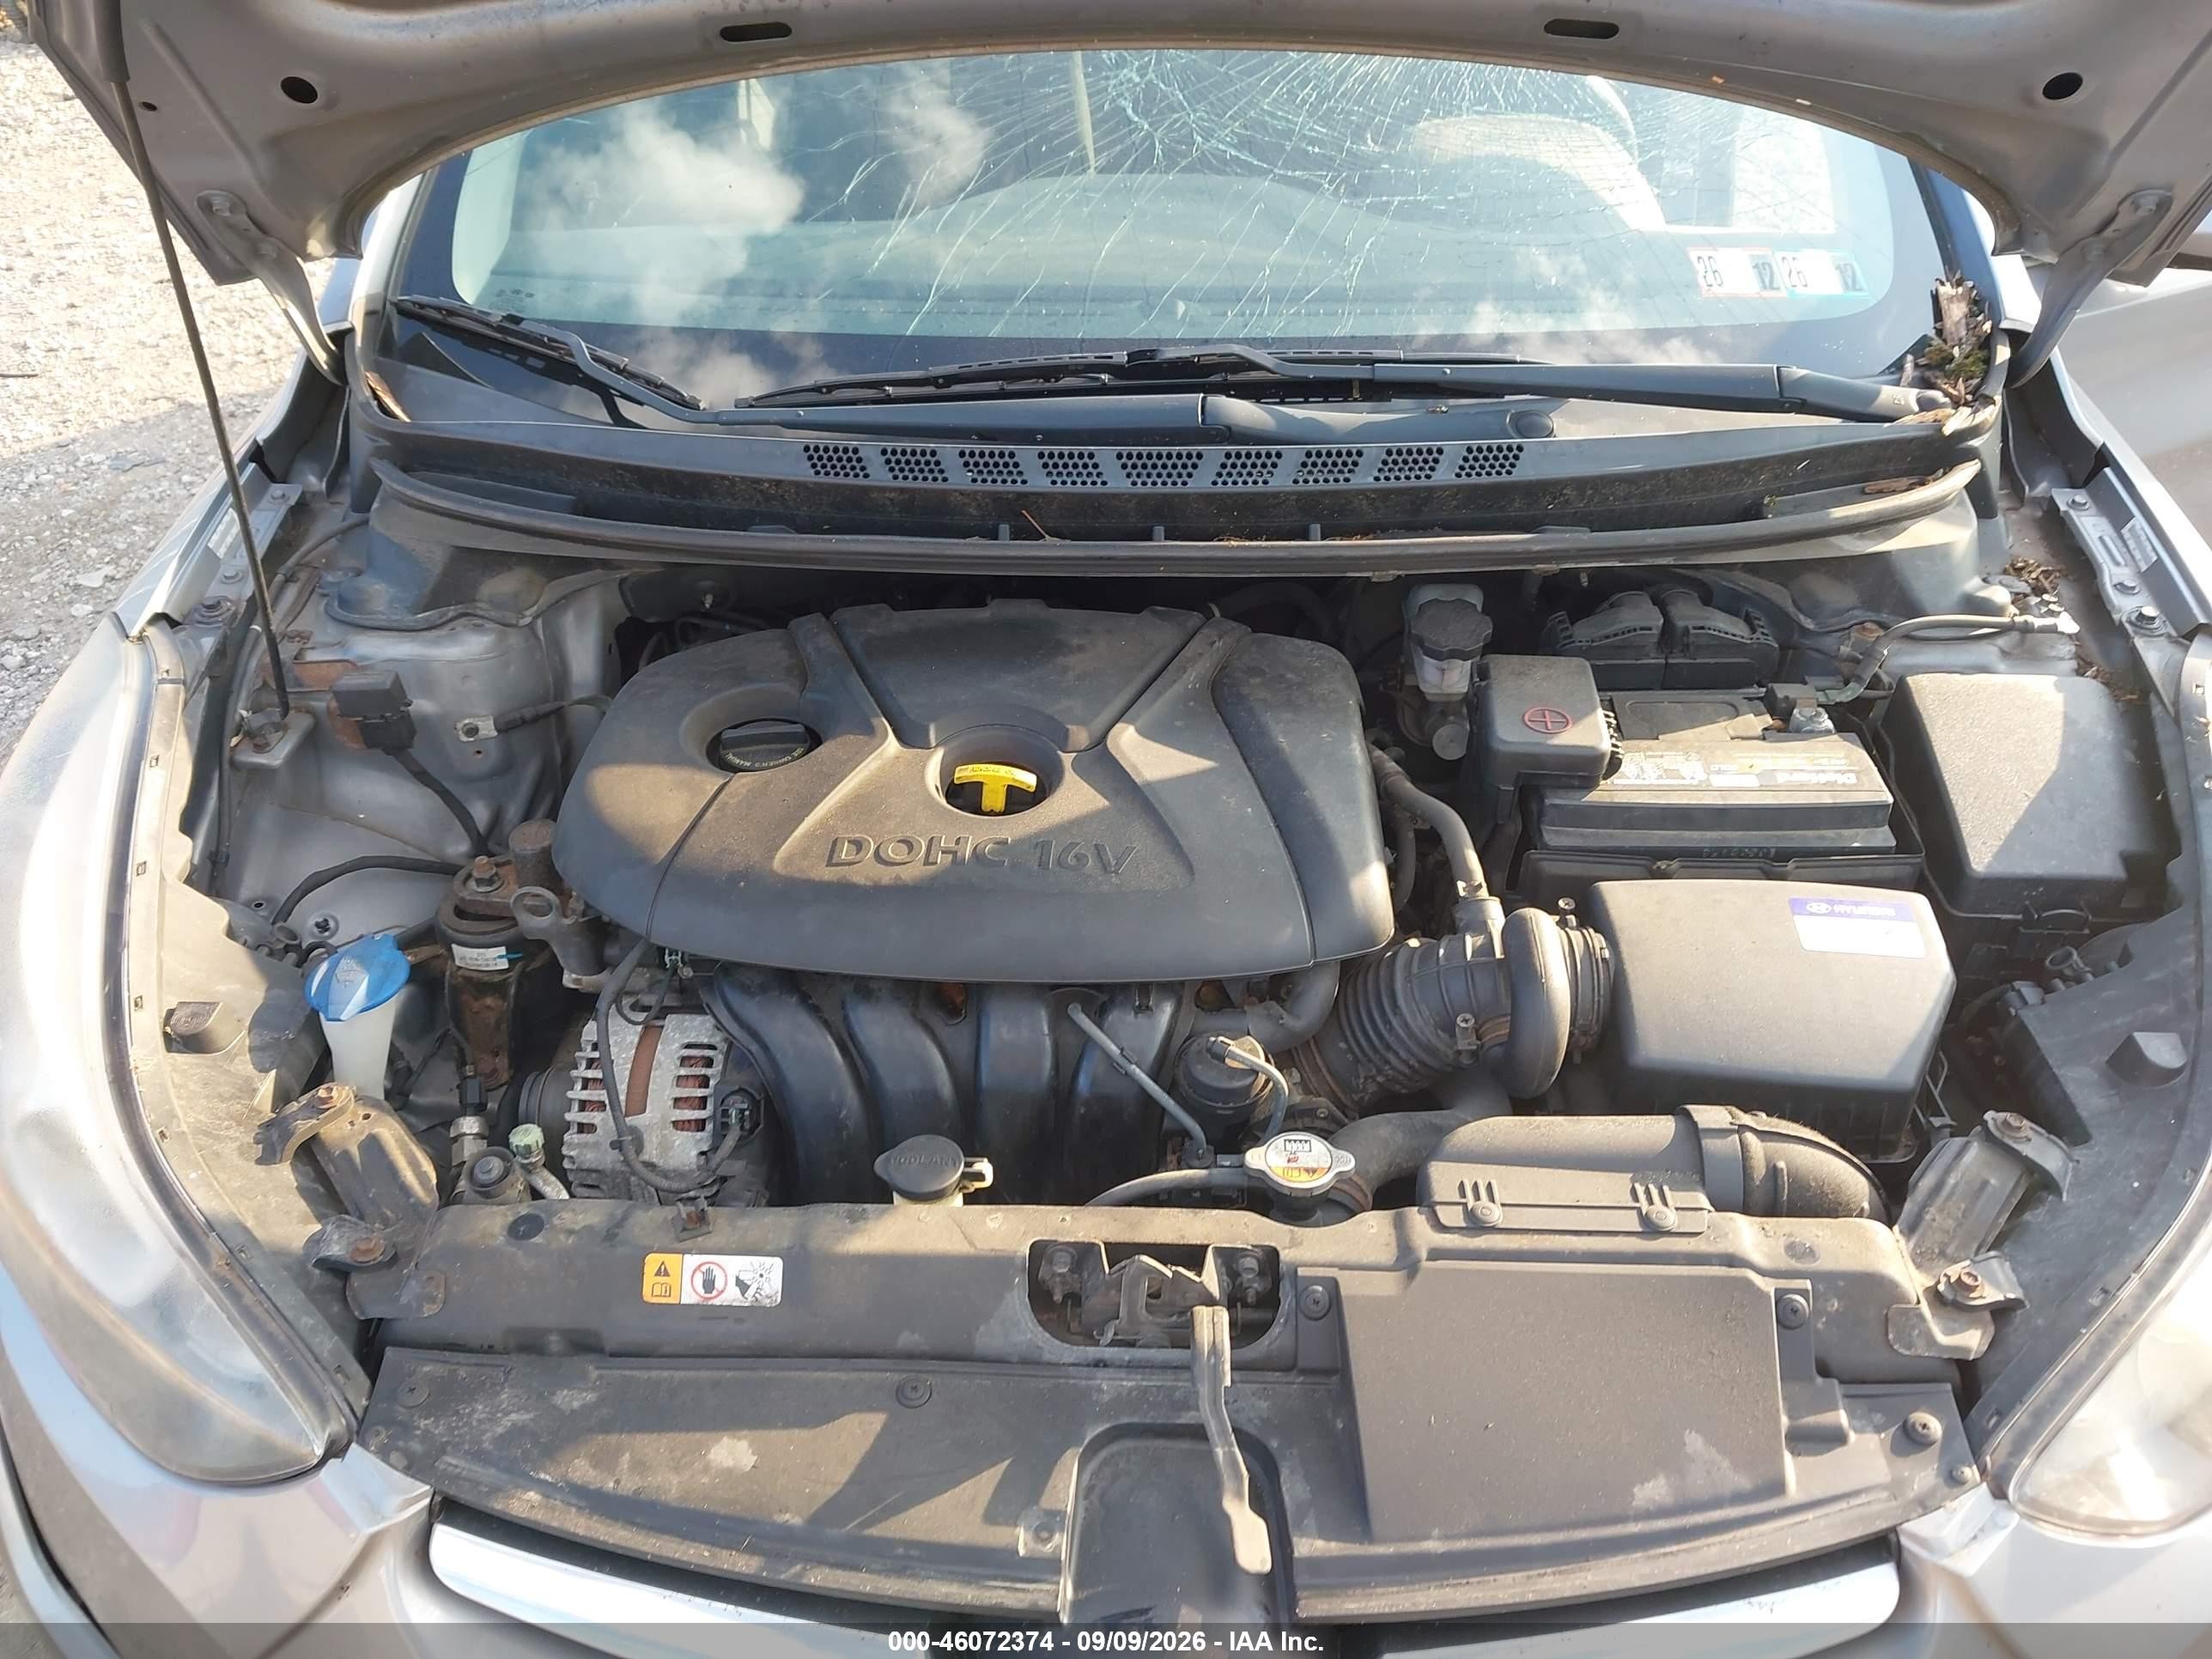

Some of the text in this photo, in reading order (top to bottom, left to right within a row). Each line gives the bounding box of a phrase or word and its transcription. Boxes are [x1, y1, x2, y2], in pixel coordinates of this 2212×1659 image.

[1697, 255, 1781, 290] 26 12
[1781, 256, 1868, 291] 26 12
[825, 834, 1139, 875] DOHC 16V
